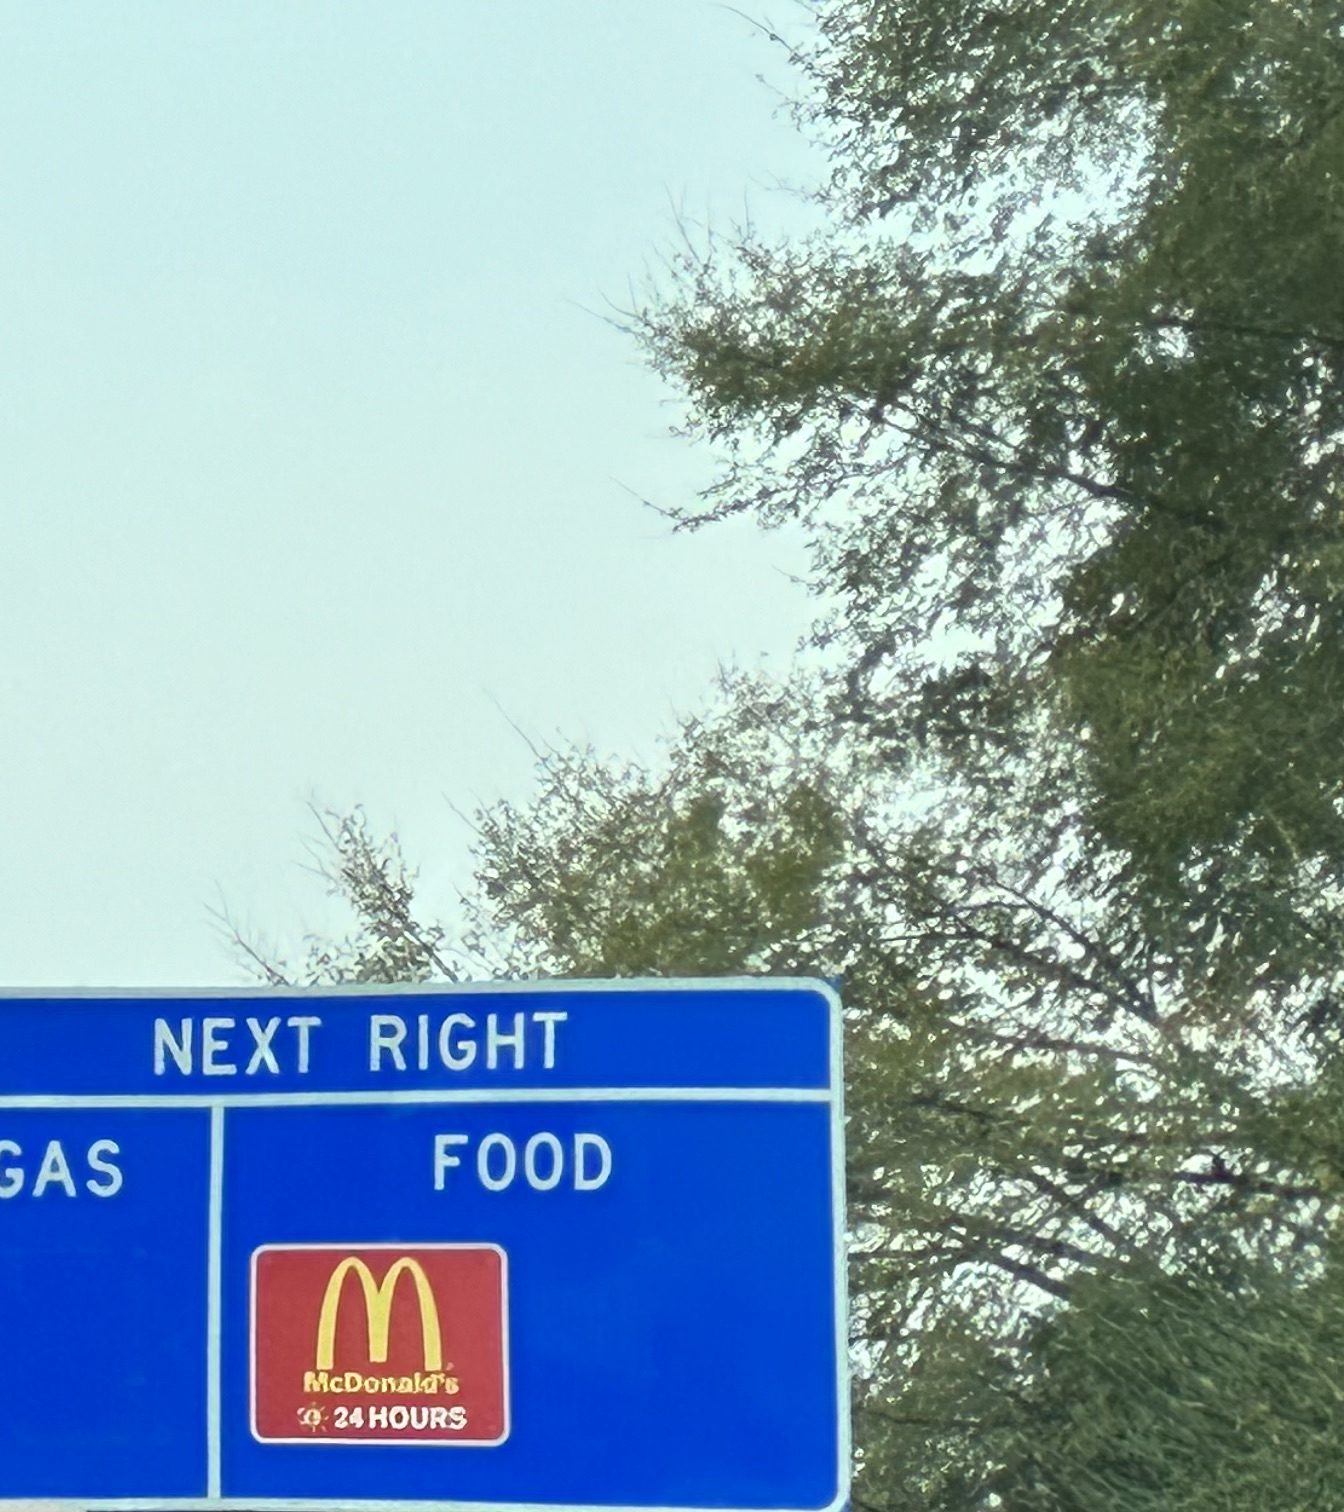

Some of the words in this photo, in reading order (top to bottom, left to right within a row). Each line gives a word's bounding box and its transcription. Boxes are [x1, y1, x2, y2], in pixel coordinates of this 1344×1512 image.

[153, 1015, 322, 1077] NEXT
[369, 1010, 569, 1072] RIGHT
[433, 1131, 613, 1192] FOOD
[303, 1370, 460, 1394] McDonald's
[333, 1406, 365, 1429] 24
[368, 1405, 468, 1430] HOURS
